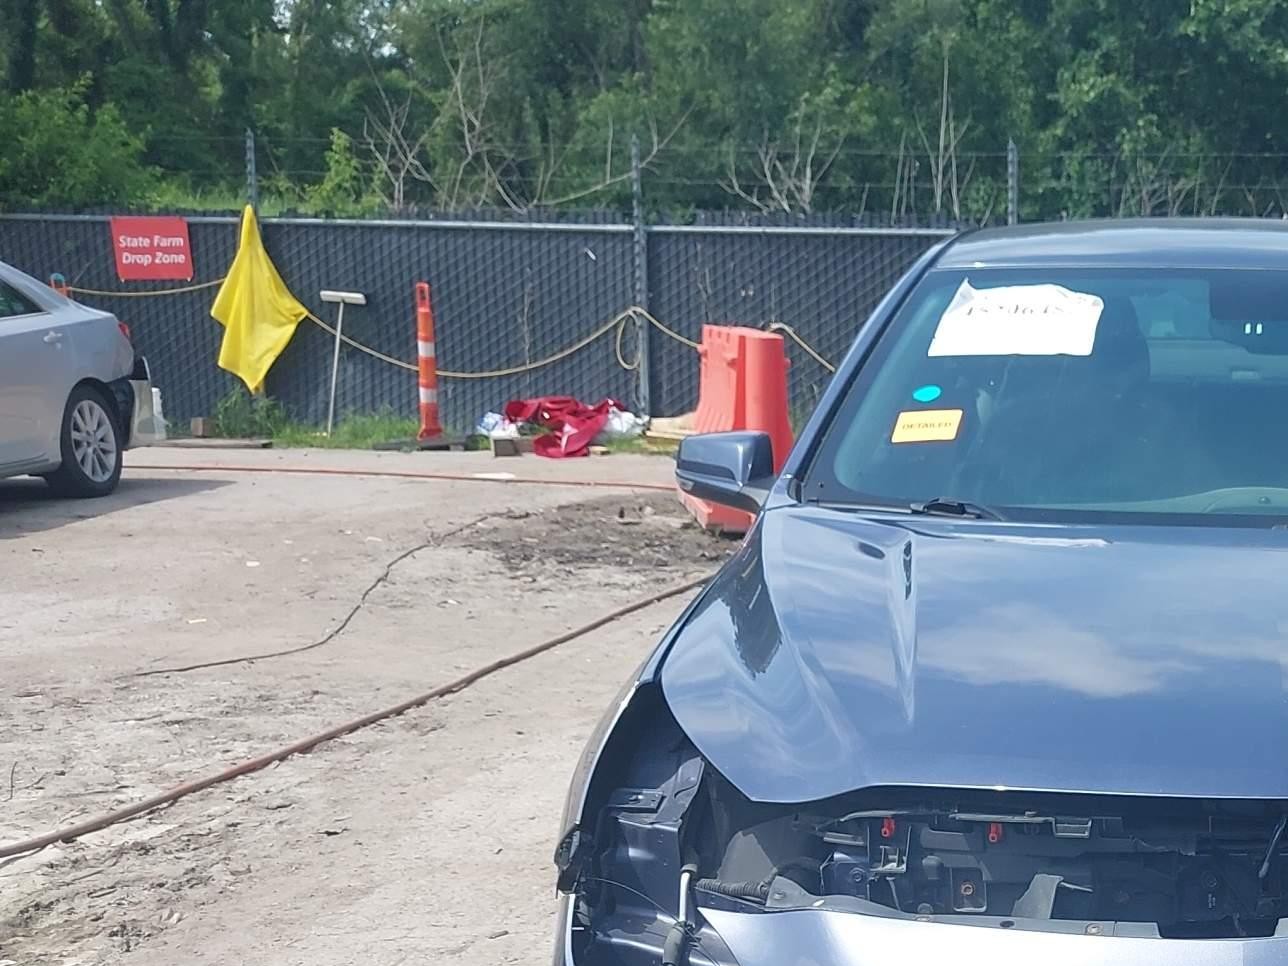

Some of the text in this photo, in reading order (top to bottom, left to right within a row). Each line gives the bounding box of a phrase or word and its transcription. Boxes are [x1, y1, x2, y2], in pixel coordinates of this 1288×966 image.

[119, 235, 184, 248] State Farm
[122, 252, 186, 267] Drop Zone
